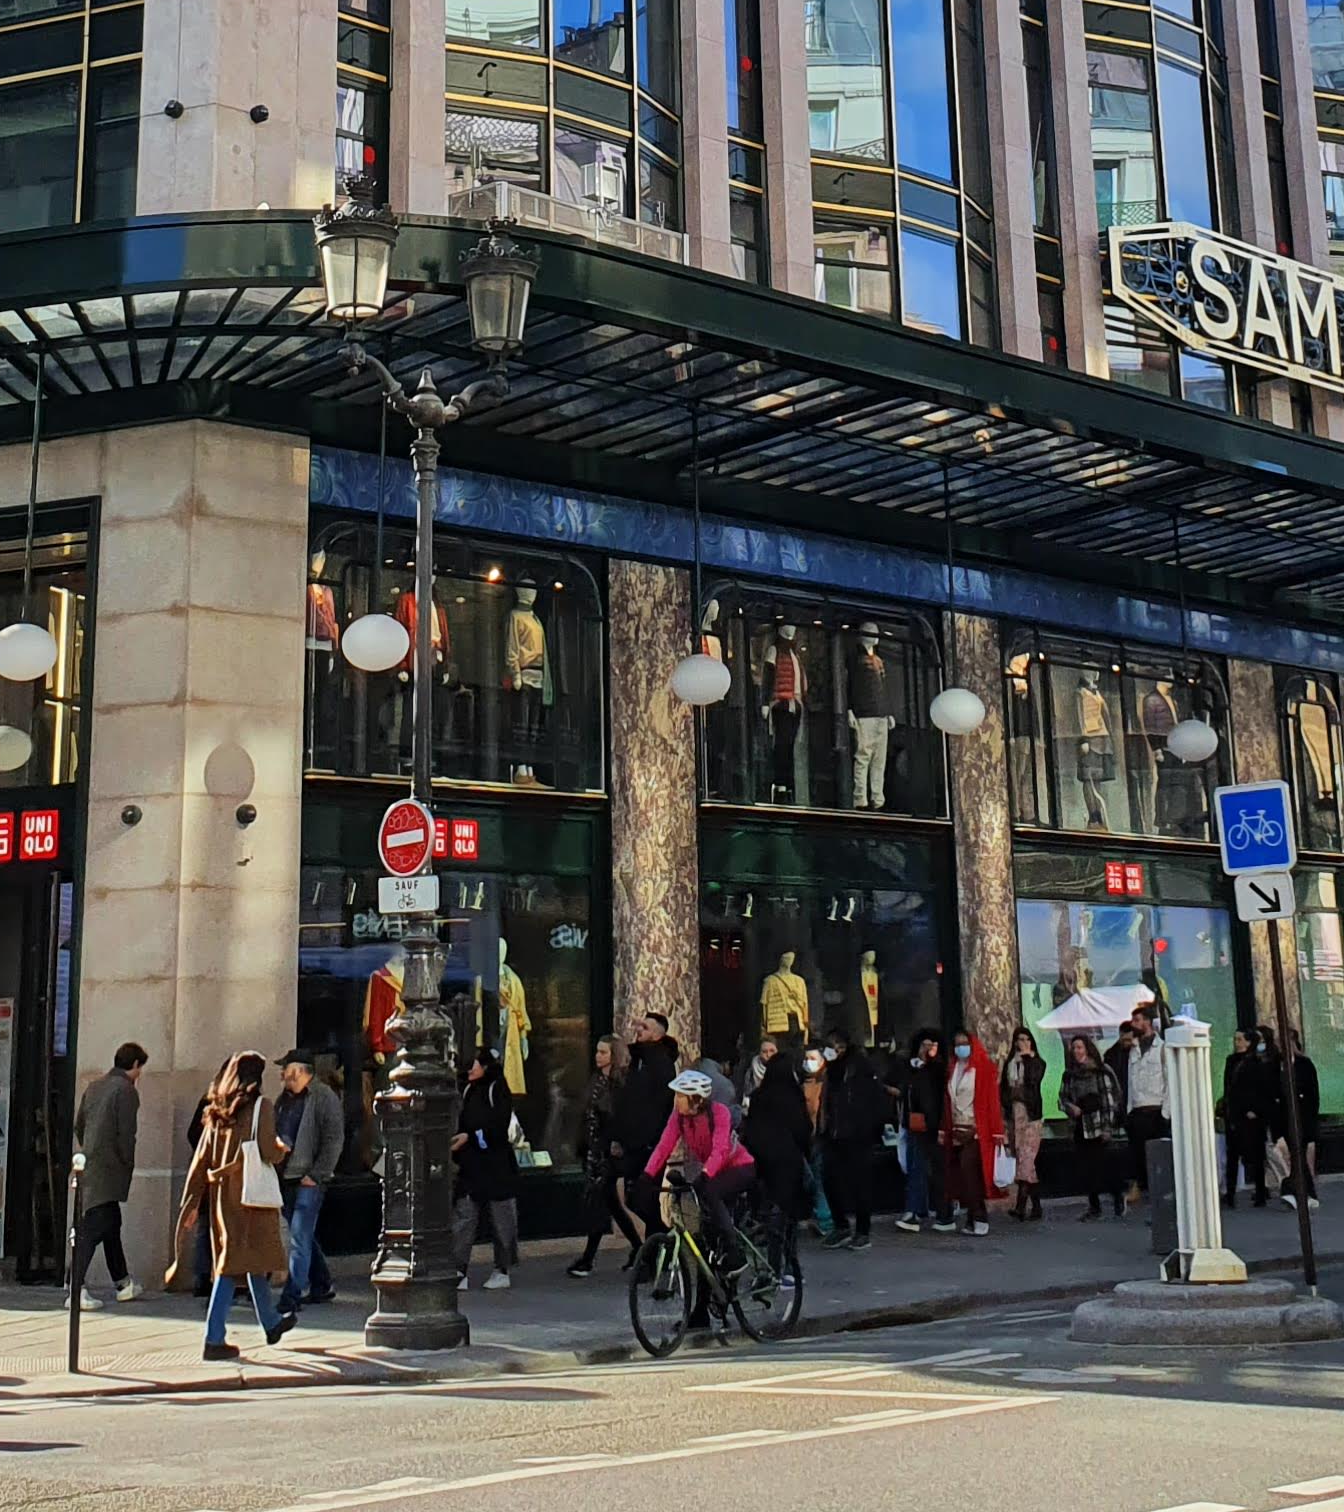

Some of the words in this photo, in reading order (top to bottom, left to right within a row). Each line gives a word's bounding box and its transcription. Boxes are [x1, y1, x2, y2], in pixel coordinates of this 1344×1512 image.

[25, 815, 52, 834] UNI
[455, 824, 473, 838] UNI
[23, 834, 54, 856] QLO
[455, 839, 475, 853] QLO
[395, 880, 419, 890] SAUF
